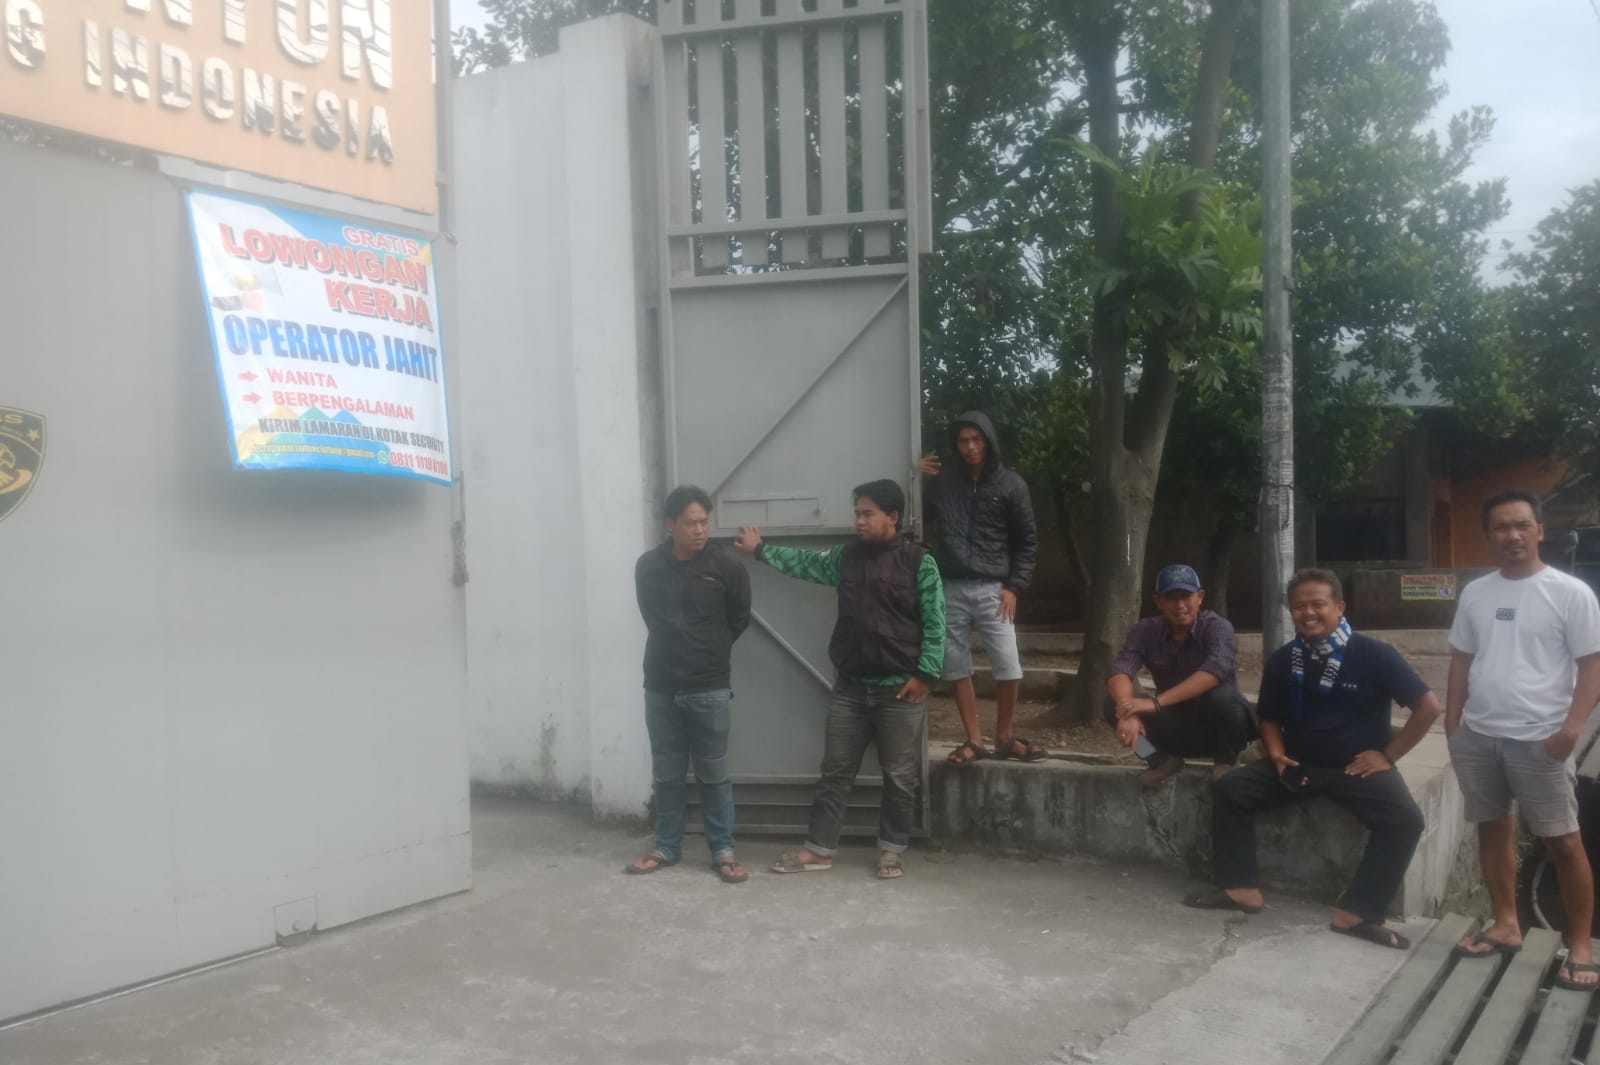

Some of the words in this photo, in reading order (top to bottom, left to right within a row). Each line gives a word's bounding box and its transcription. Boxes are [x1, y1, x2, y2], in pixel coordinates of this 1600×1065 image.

[84, 18, 395, 163] INDONESIA
[219, 223, 429, 293] LOWONGAN
[342, 225, 419, 257] GRATIS
[324, 278, 434, 332] KERJA
[223, 314, 380, 370] OPERATOR
[383, 335, 439, 384] JAHIT
[268, 369, 338, 389] WANITA
[273, 391, 415, 420] BERPENGALAMAN
[258, 418, 301, 433] KIRIM
[304, 420, 361, 438] LAMARAN
[362, 426, 375, 441] DI
[375, 427, 409, 446] KOTAK
[410, 432, 444, 454] SECURITY
